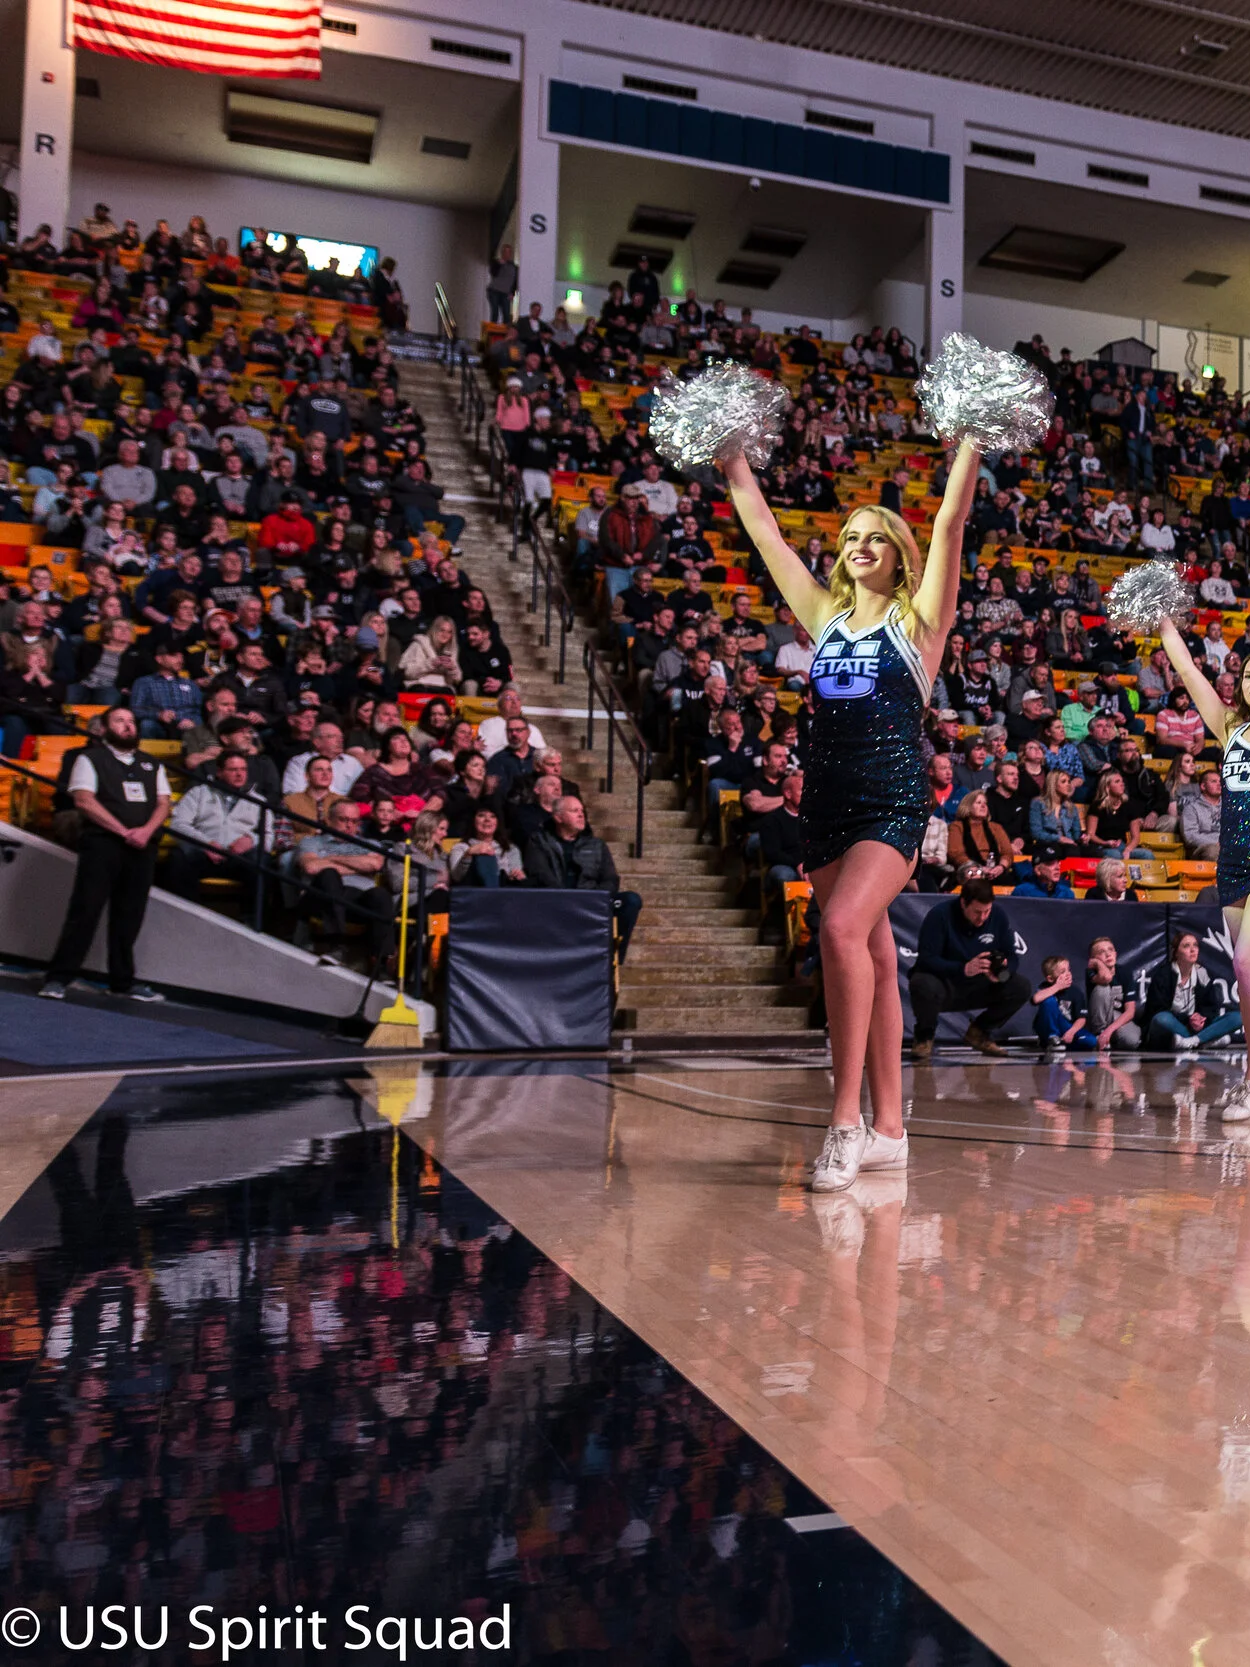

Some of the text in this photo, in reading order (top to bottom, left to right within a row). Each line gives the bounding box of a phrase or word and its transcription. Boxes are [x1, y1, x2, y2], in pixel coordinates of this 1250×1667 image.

[35, 132, 55, 156] R
[530, 213, 547, 234] S
[940, 279, 955, 298] S
[811, 657, 880, 680] STATE
